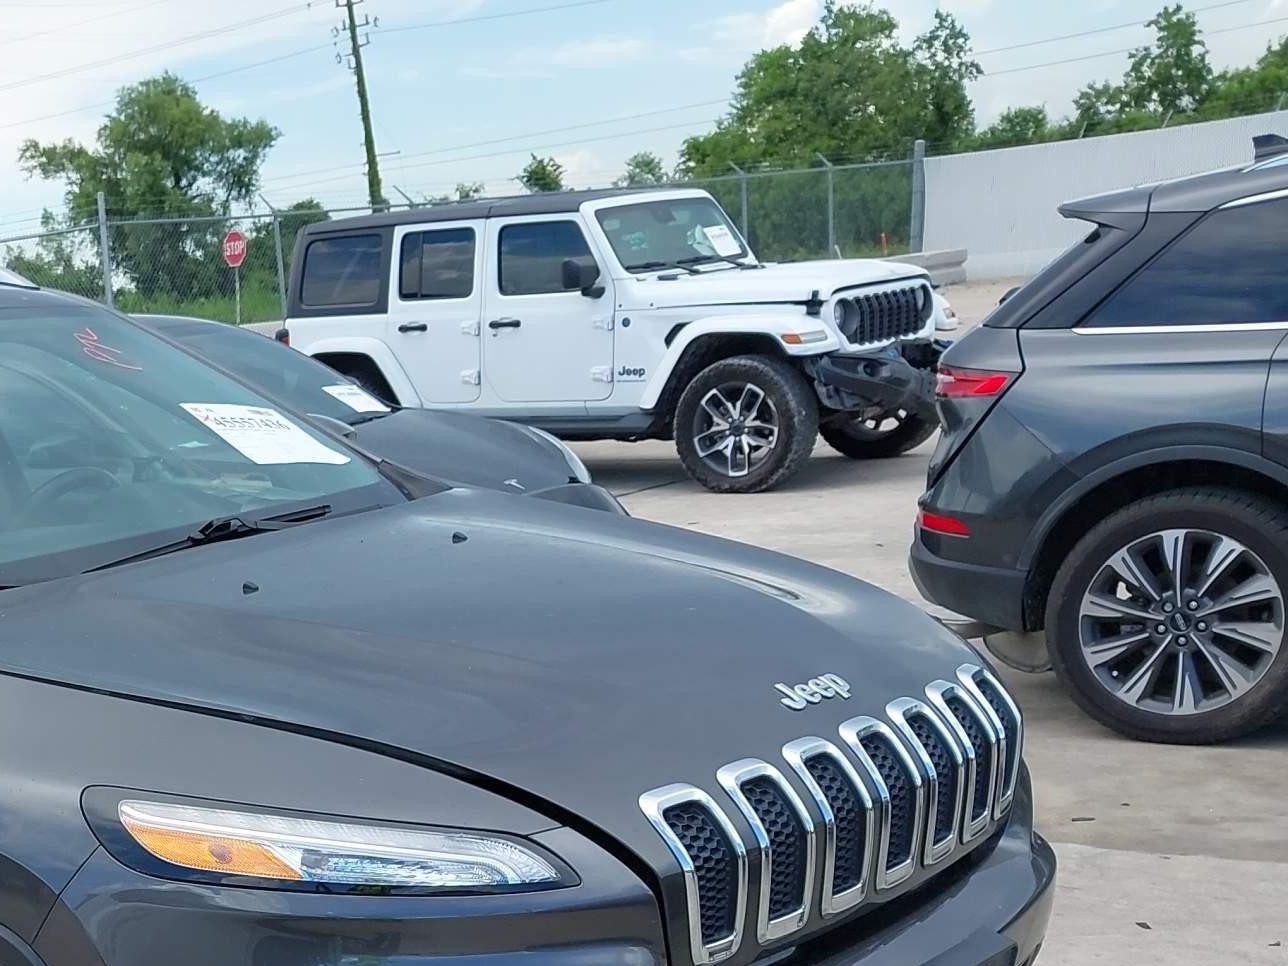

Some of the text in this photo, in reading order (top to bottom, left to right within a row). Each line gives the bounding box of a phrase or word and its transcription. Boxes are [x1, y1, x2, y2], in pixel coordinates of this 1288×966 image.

[226, 240, 245, 256] STOP
[618, 365, 646, 378] Jeep
[774, 673, 852, 711] Jeep
